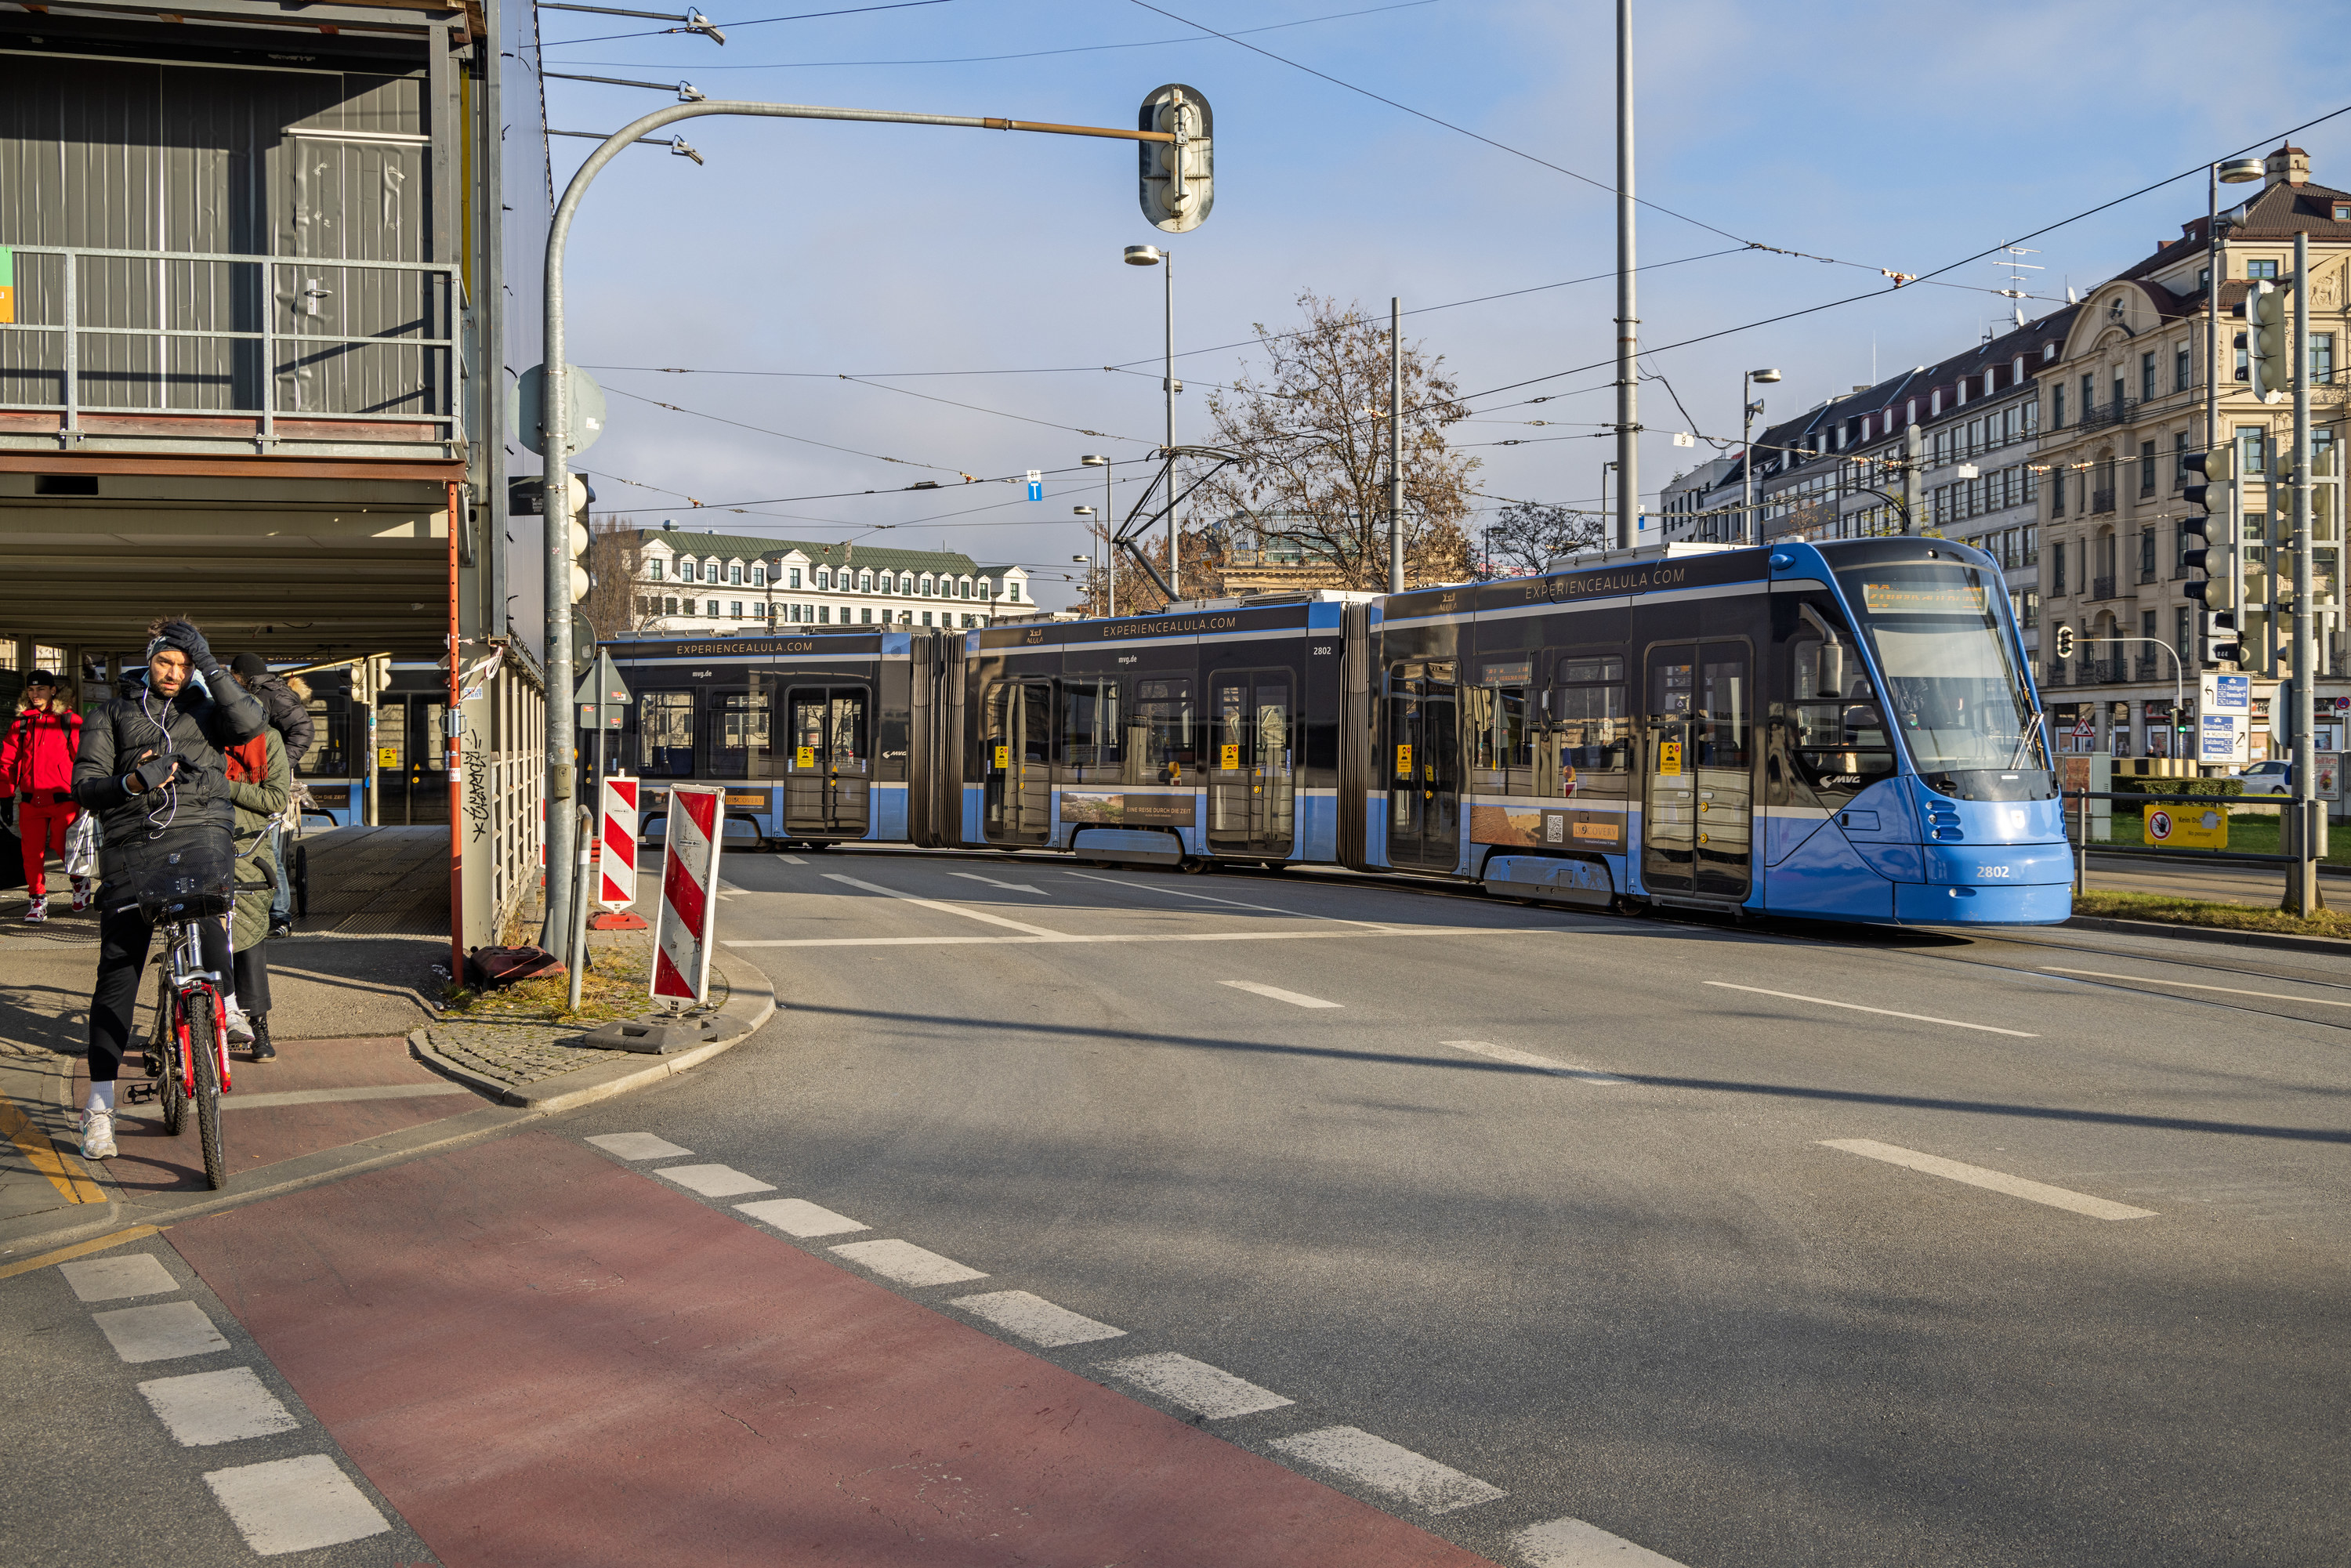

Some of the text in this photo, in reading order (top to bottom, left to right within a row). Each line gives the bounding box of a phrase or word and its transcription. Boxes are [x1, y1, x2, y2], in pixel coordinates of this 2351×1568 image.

[1031, 483, 1039, 499] T
[1103, 617, 1236, 636] EXPERIENCEALULA.COM
[676, 642, 813, 654] EXPERIENCEALULA.COM
[1313, 646, 1331, 655] 2802
[1118, 655, 1137, 664] mvg.de
[692, 670, 712, 679] mvg.de
[1976, 866, 2009, 878] 2802
